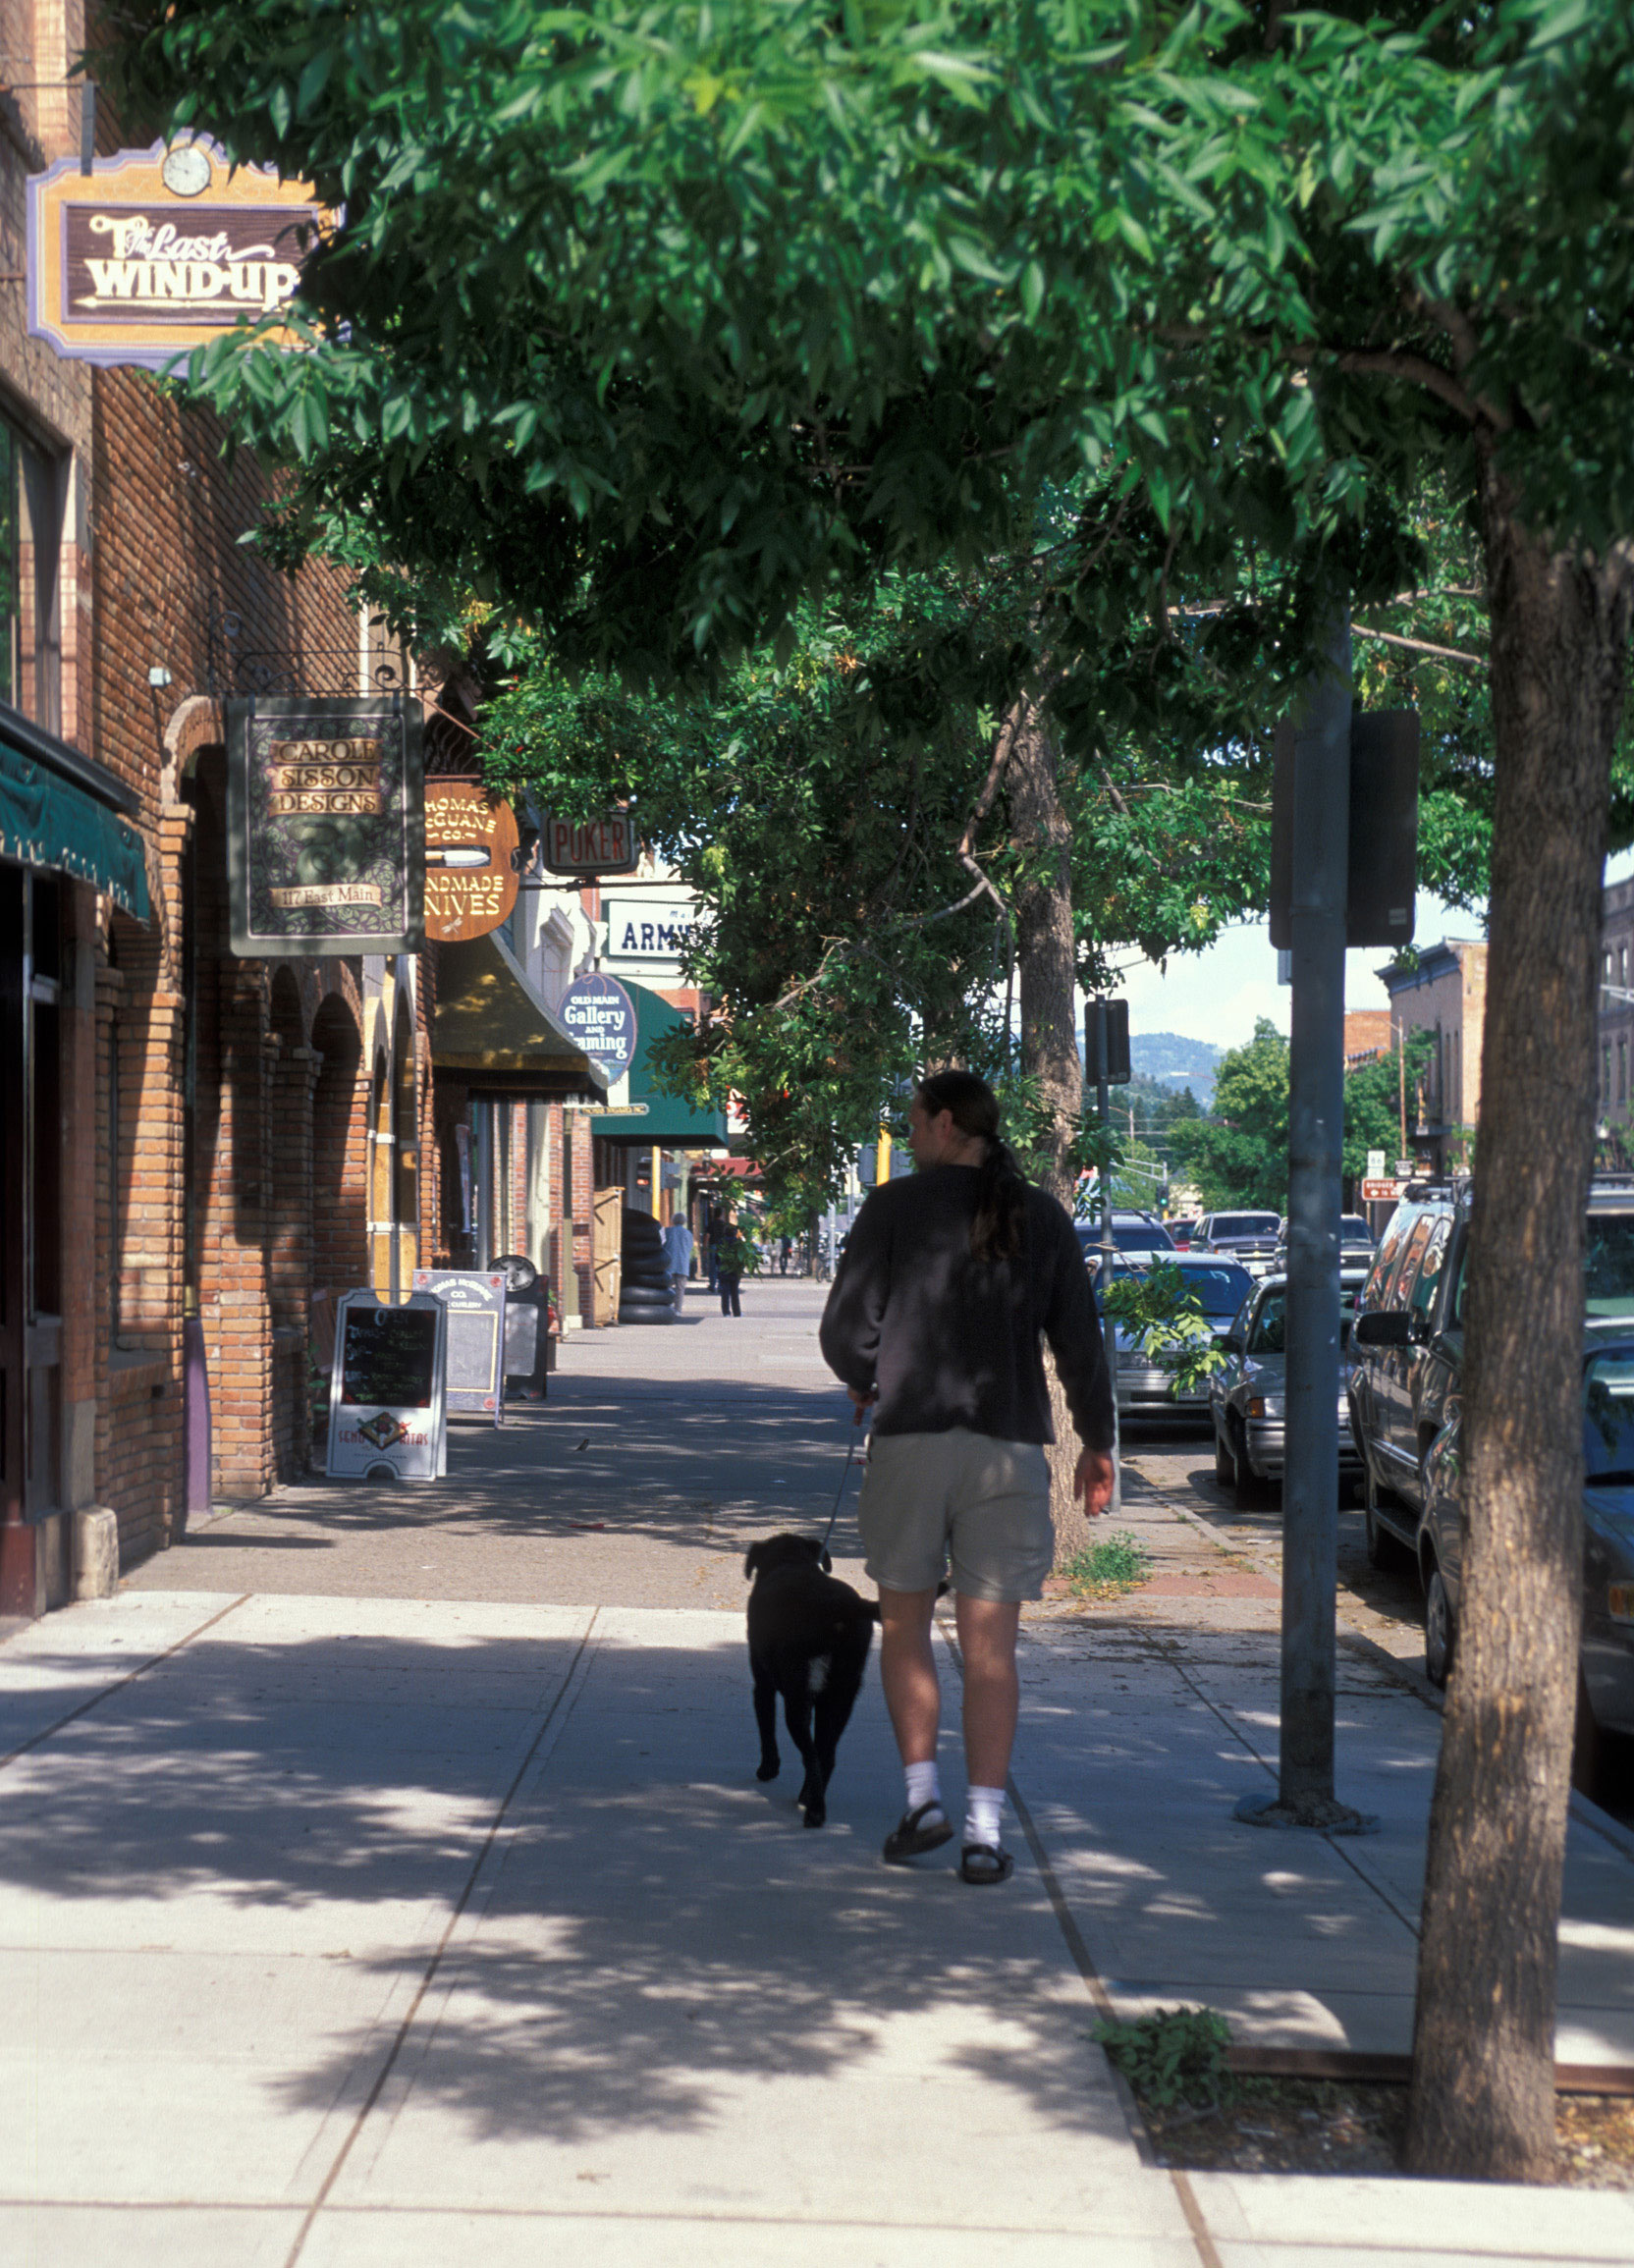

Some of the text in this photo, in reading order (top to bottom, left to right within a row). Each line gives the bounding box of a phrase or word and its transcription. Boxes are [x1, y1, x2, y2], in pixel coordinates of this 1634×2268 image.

[145, 224, 275, 261] Last
[83, 258, 300, 312] WIND-UP
[278, 740, 376, 762] CAROLE
[280, 767, 375, 788] SISSON
[279, 792, 377, 813] DESIGNS
[424, 798, 489, 815] HOMAS
[424, 812, 497, 834] cGUANE
[442, 830, 466, 840] CO.
[555, 821, 625, 863] POKER
[424, 875, 504, 892] NDMADE
[281, 887, 374, 905] 117 East Main
[423, 893, 501, 916] NIVES
[571, 996, 620, 1005] OLD MAIN
[565, 1005, 626, 1031] Gallery
[569, 1032, 627, 1059] aming
